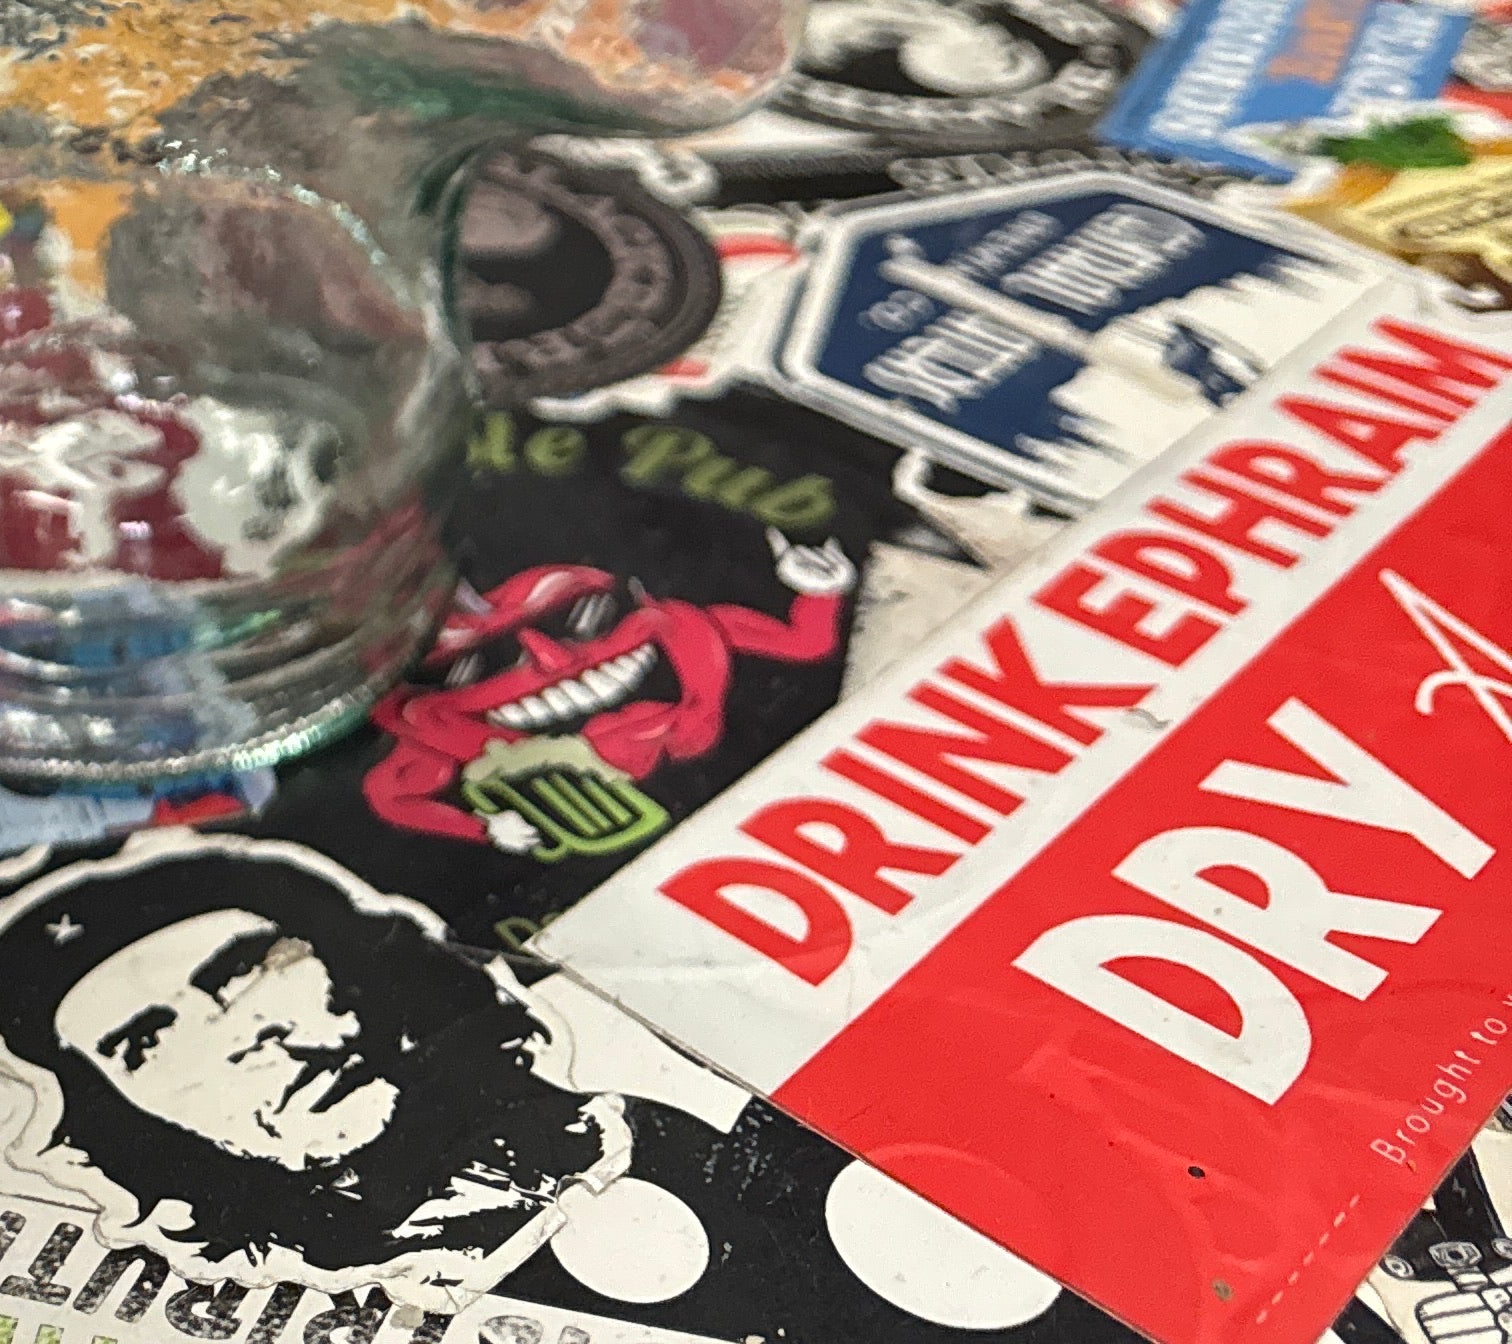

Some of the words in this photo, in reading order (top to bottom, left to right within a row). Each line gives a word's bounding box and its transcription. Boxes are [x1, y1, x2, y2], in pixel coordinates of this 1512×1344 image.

[622, 426, 836, 526] Pub
[659, 617, 1156, 985] DRINK
[1036, 317, 1512, 666] EPHRAIM
[1013, 698, 1496, 1104] DRY
[1370, 1051, 1481, 1165] Brought
[1471, 1018, 1507, 1045] to
